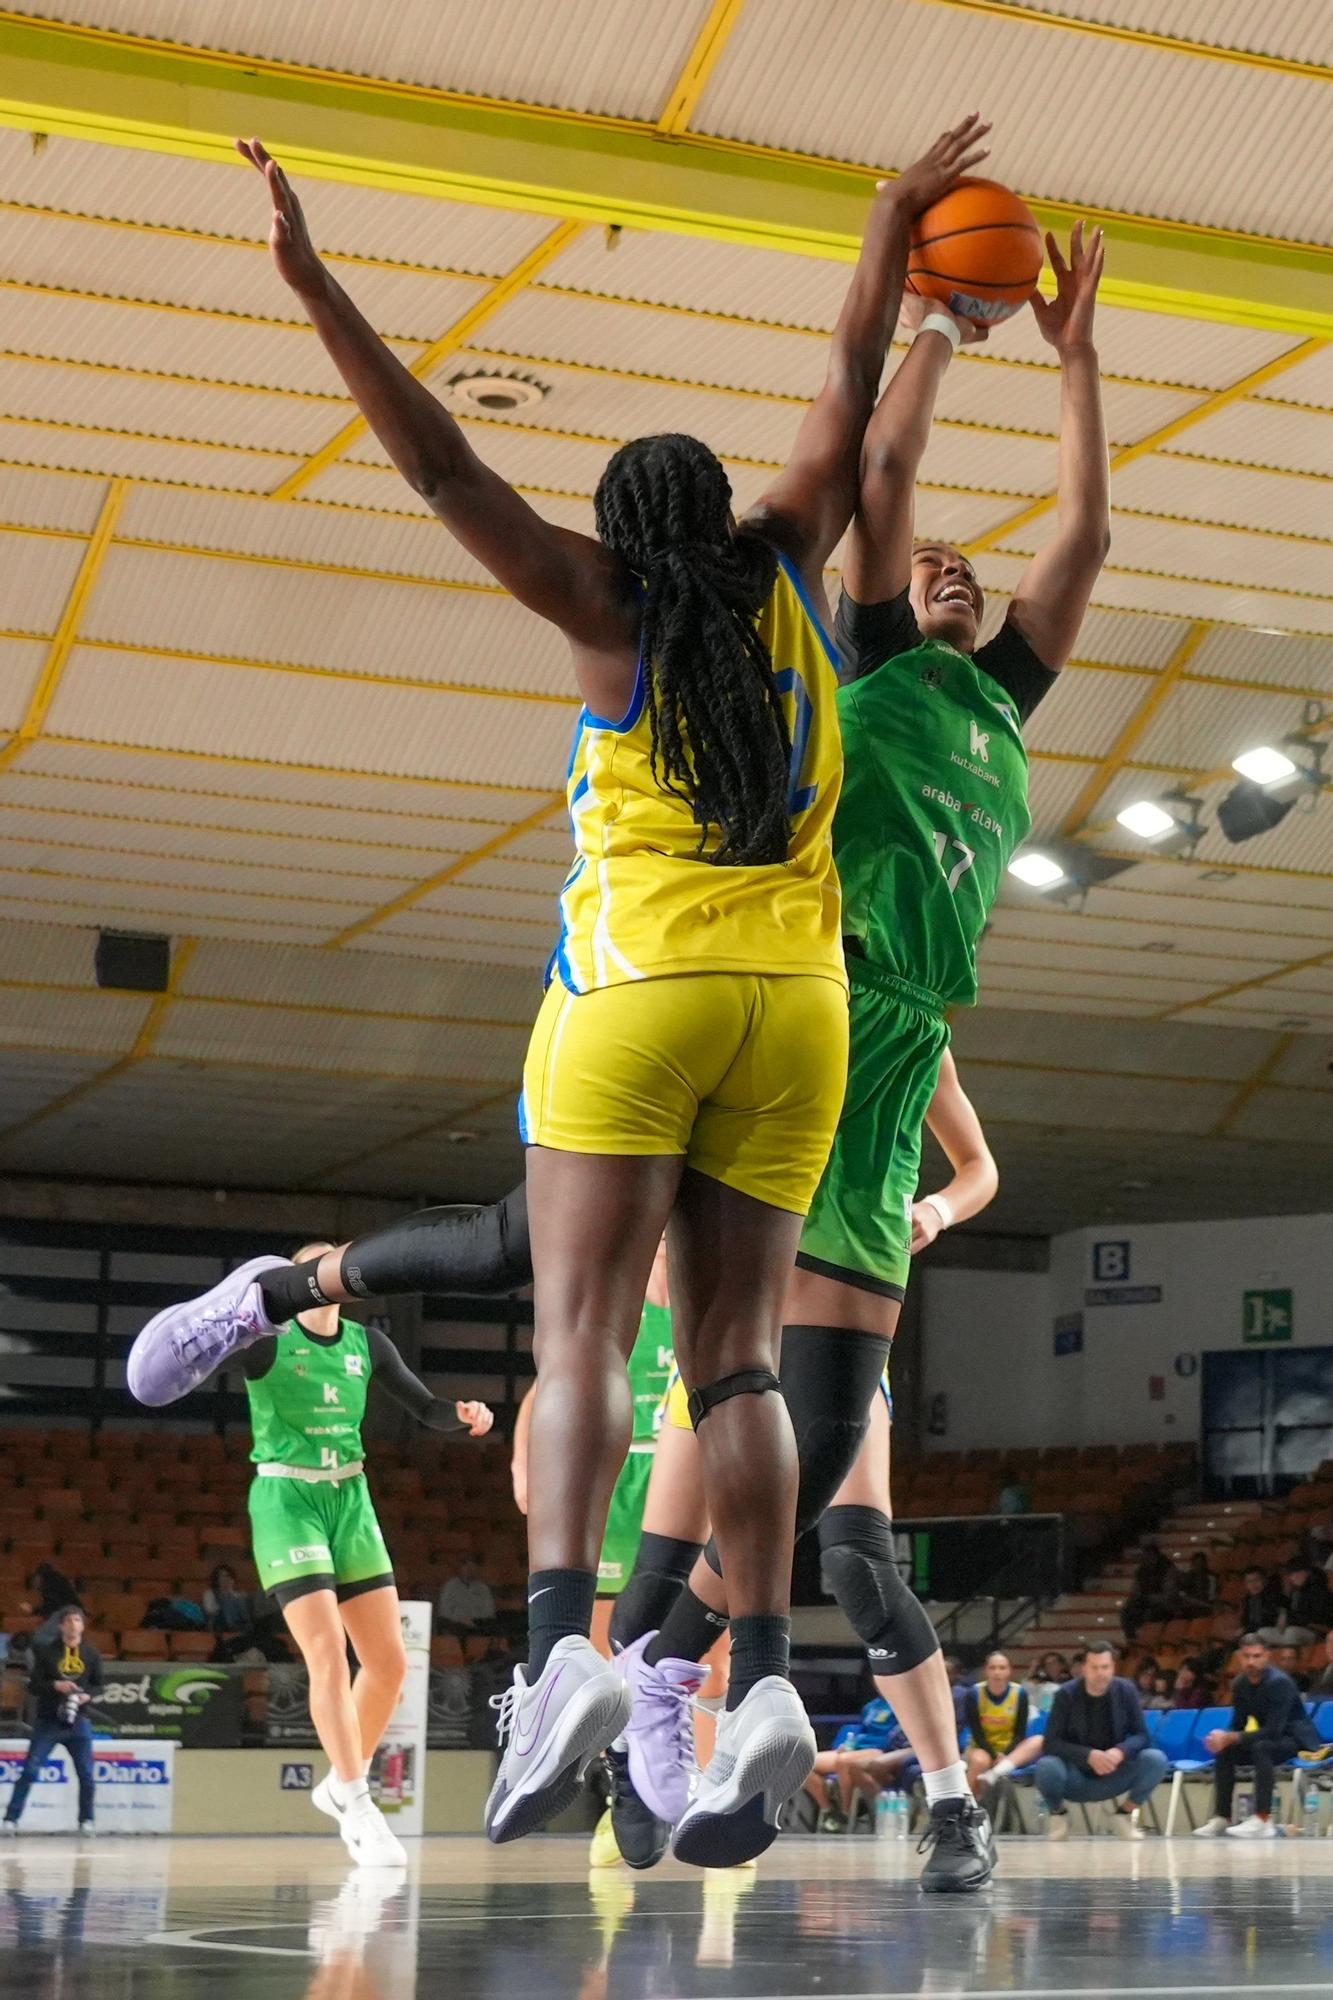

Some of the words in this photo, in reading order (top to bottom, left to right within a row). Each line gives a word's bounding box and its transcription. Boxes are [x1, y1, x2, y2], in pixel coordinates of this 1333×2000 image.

[951, 751, 1000, 788] kutxabank
[922, 784, 962, 813] araba
[933, 831, 976, 894] 17
[1099, 1244, 1125, 1277] B
[94, 1759, 162, 1783] Diario
[283, 1766, 312, 1788] A3
